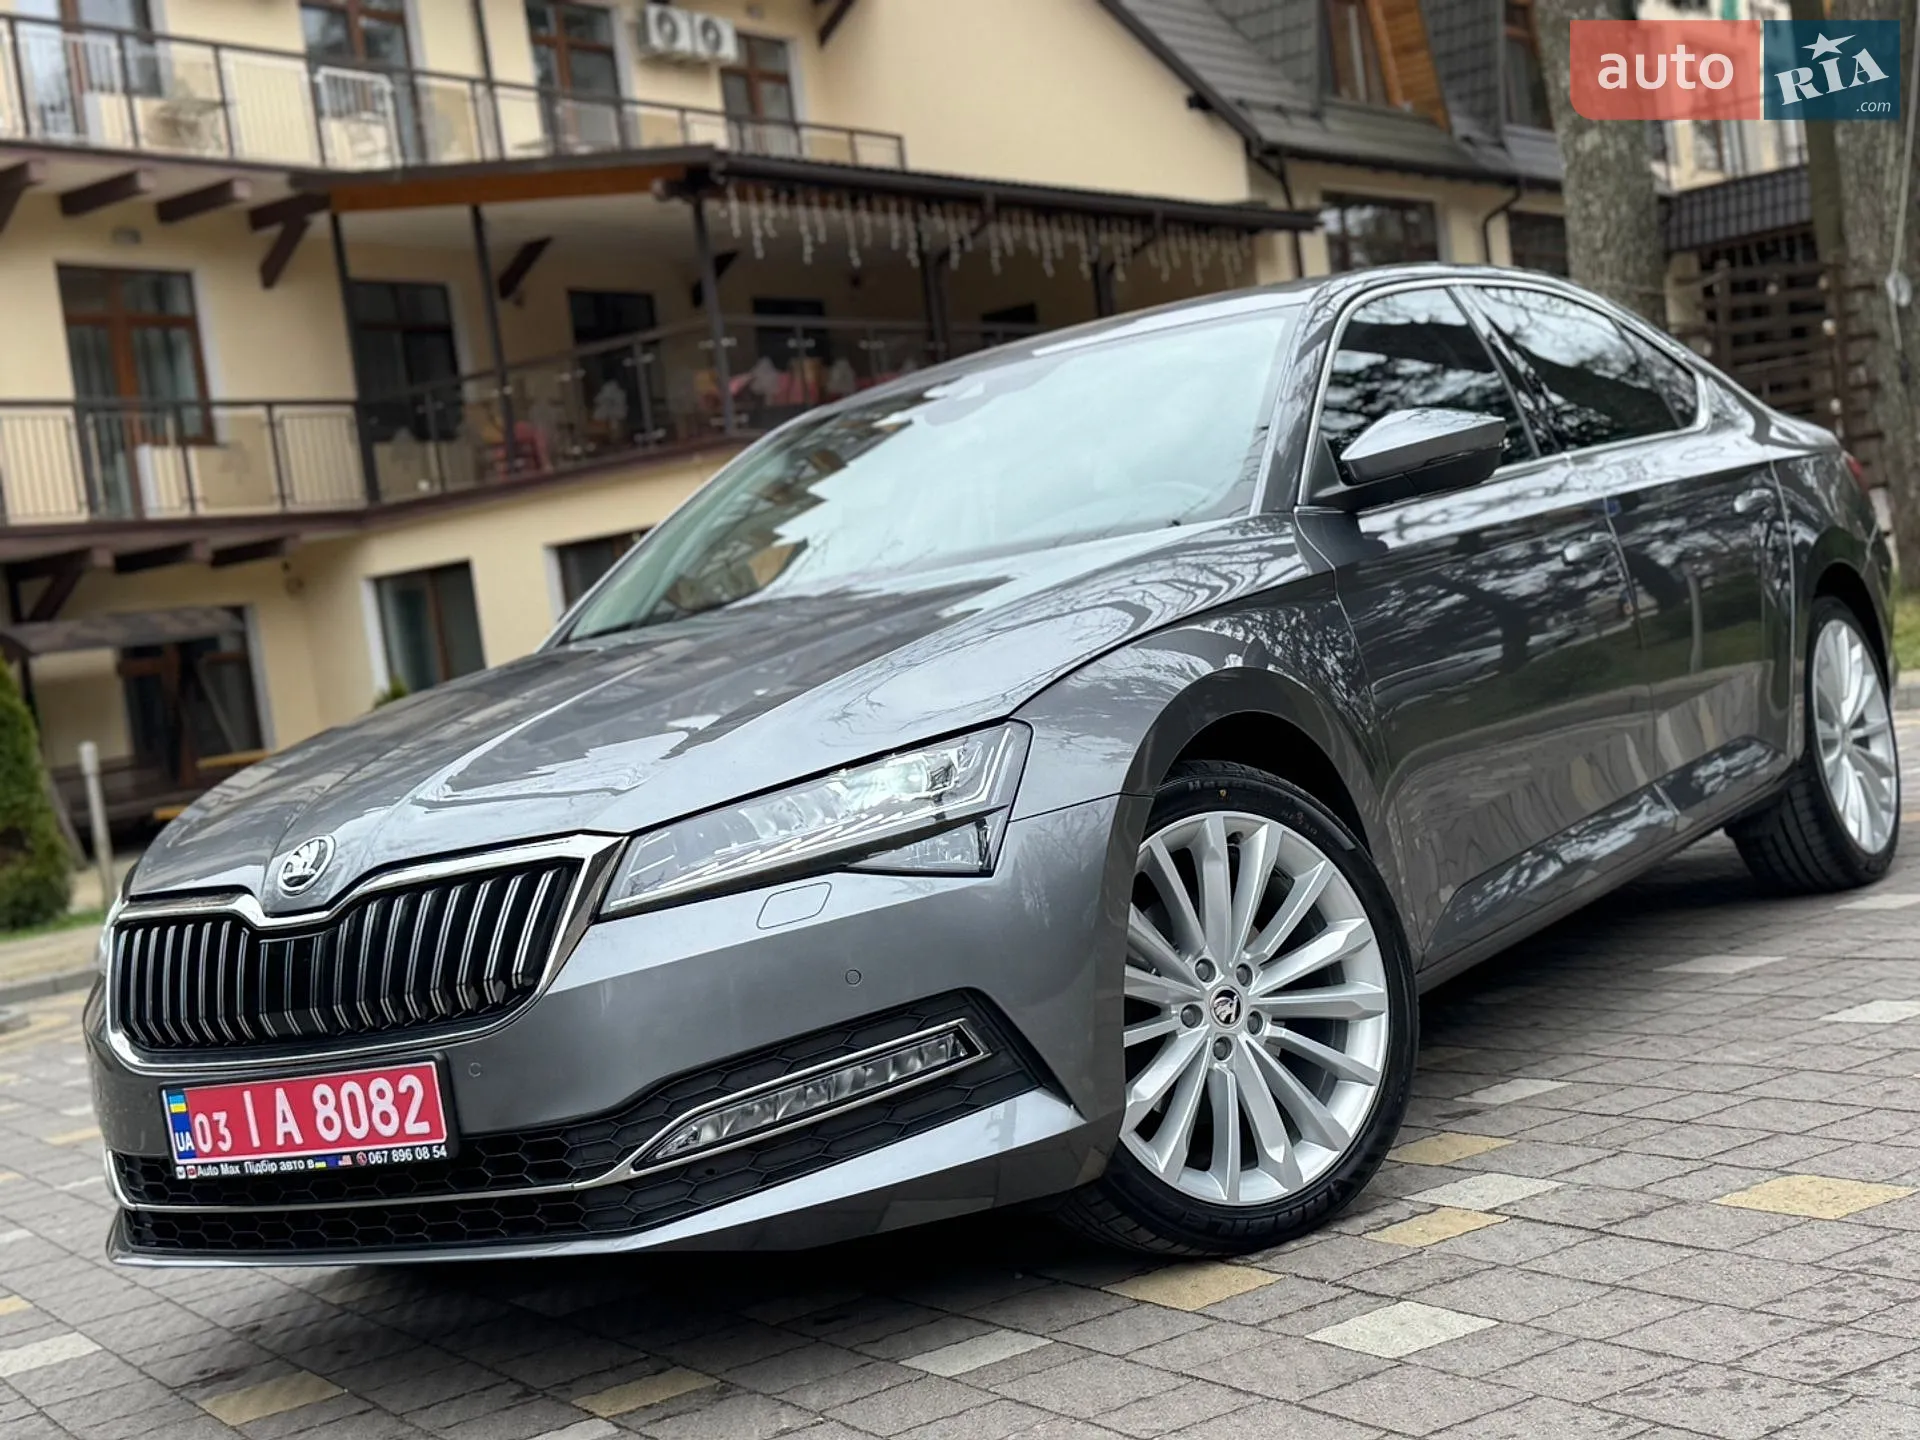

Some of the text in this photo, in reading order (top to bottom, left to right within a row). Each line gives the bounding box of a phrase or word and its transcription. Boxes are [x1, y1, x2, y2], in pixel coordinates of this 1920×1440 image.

[193, 1074, 430, 1152] 03 IA 8082
[175, 1131, 194, 1151] UA
[368, 1150, 389, 1165] 067
[415, 1146, 431, 1160] 08
[432, 1144, 447, 1158] 54
[197, 1162, 241, 1176] Auto Max
[279, 1159, 305, 1171] авто
